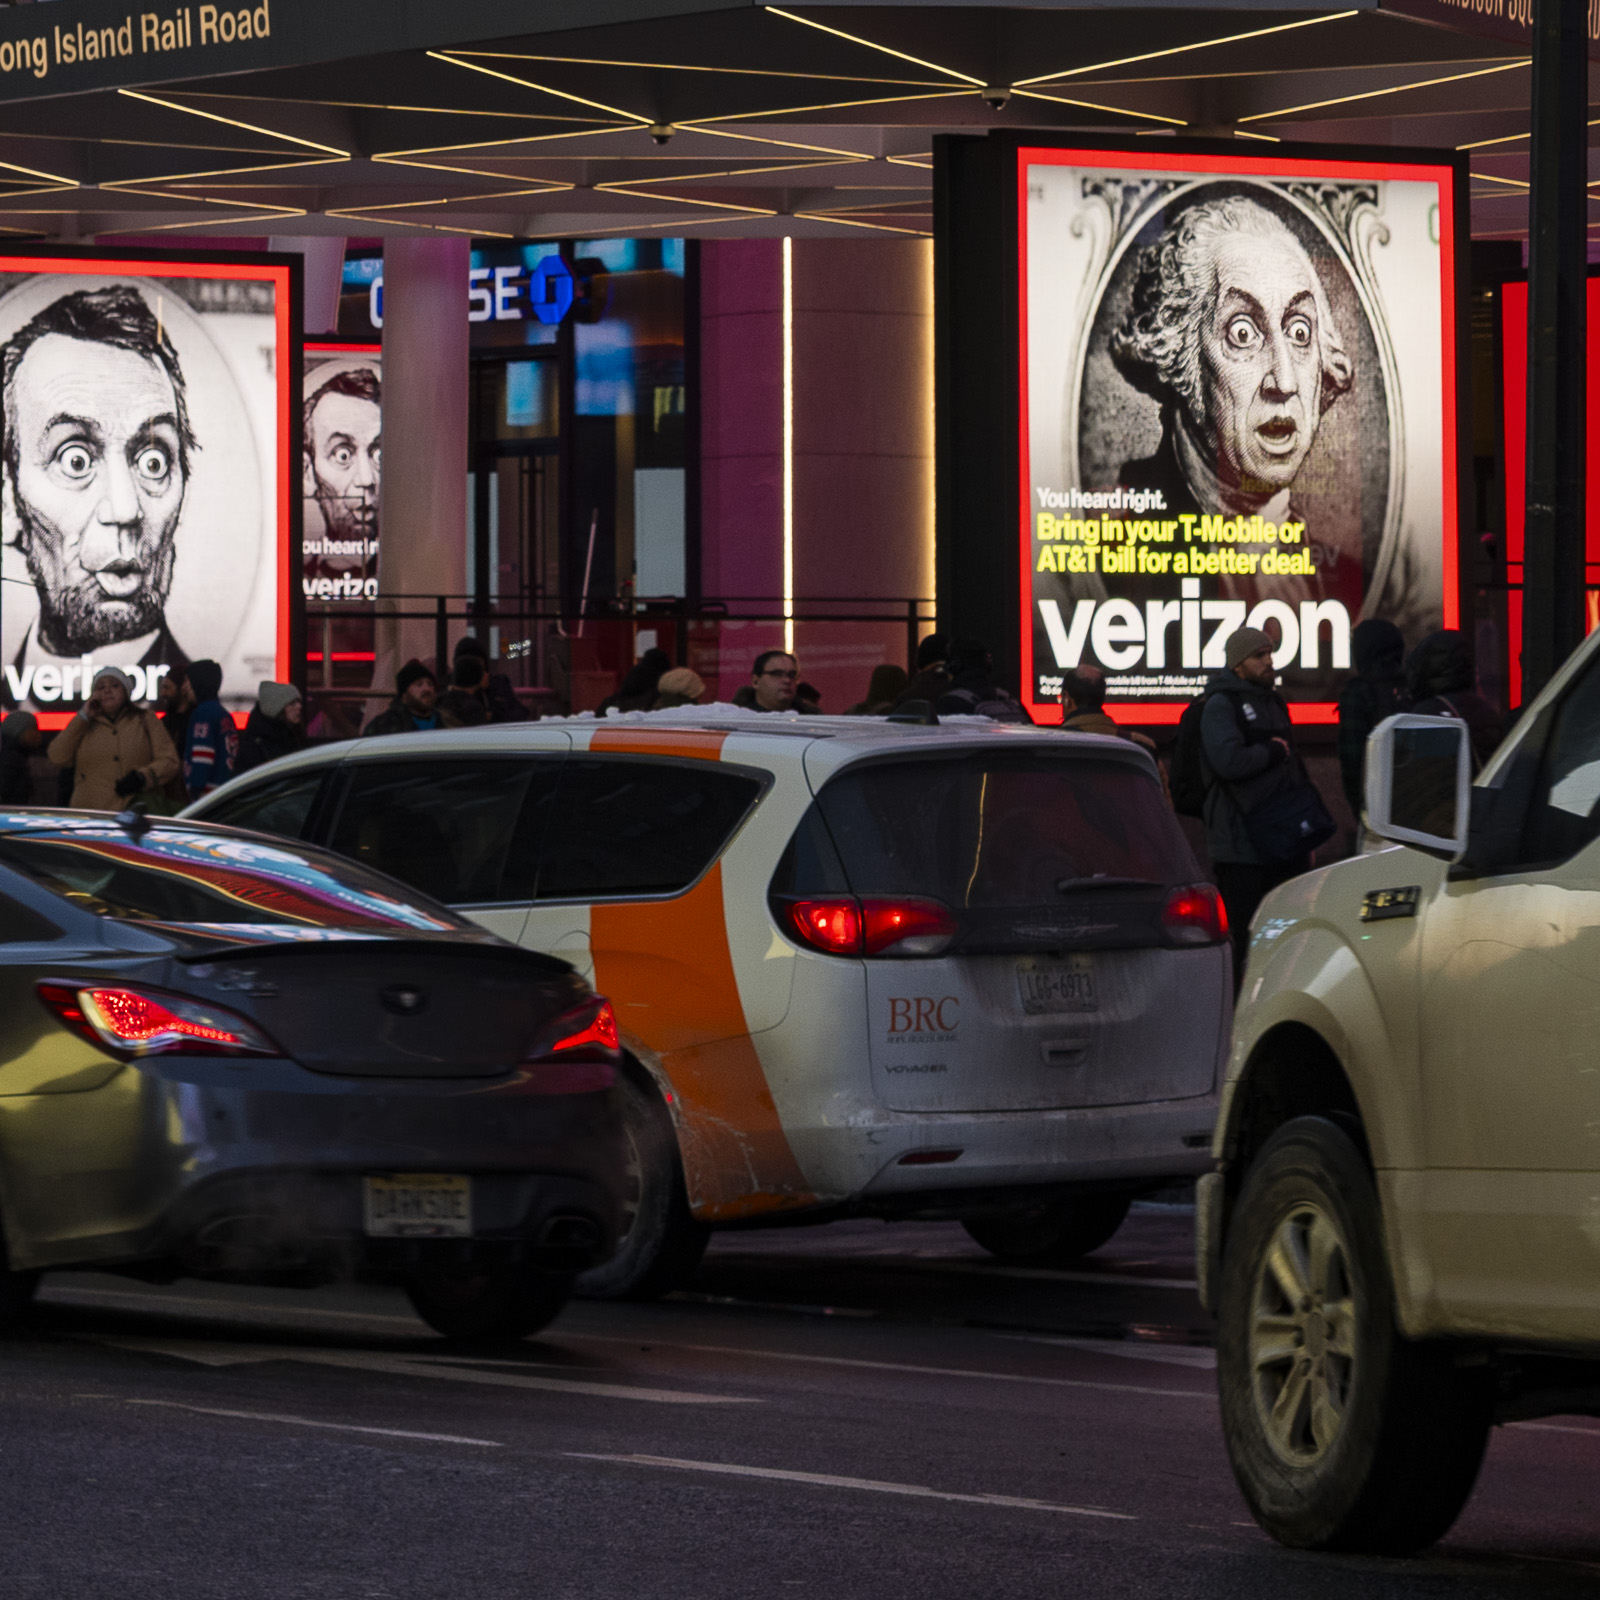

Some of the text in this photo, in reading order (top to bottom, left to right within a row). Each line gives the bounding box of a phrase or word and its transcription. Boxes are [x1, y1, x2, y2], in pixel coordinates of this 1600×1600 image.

[54, 16, 133, 65] Island
[141, 8, 192, 53] Rail
[1036, 487, 1167, 513] You heard right.
[1036, 512, 1305, 546] Bring in your T-Mobile or
[1036, 545, 1101, 573] AT&T
[1102, 545, 1136, 573] bill
[1137, 545, 1173, 574] for
[1173, 552, 1189, 574] a
[1190, 546, 1260, 574] better
[1261, 547, 1316, 575] deal.
[302, 571, 379, 601] verizo
[1037, 577, 1351, 670] verizon
[887, 996, 961, 1033] BRC
[885, 1064, 948, 1074] VOYAGER
